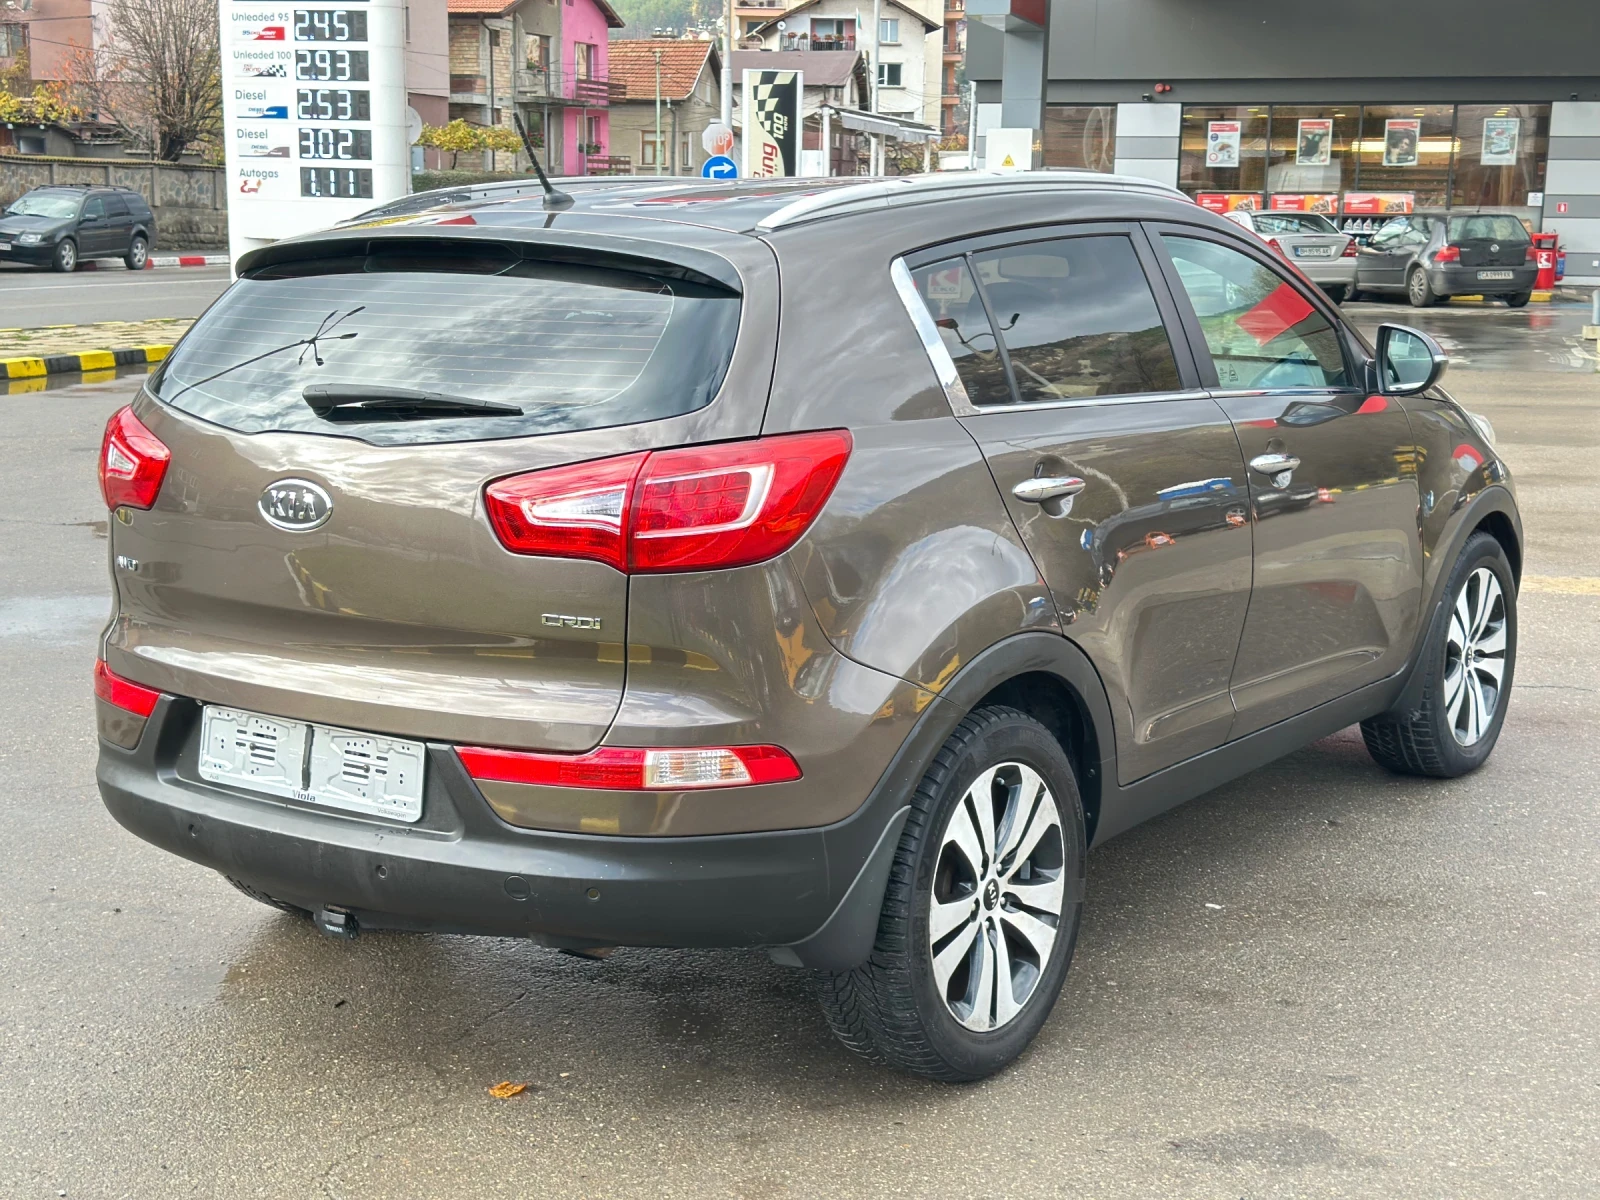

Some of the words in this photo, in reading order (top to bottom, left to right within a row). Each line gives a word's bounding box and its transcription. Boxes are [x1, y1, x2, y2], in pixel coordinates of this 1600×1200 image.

[232, 12, 275, 22] Unleaded
[277, 12, 289, 22] 95
[295, 10, 349, 41] 2.45
[233, 50, 274, 60] Unleaded
[276, 50, 292, 60] 100
[296, 50, 351, 80] 2.93
[235, 89, 267, 100] Diesel
[298, 89, 352, 119] 2.53
[236, 128, 268, 139] Diesel
[773, 112, 784, 139] 100
[300, 128, 353, 159] 3.02
[239, 168, 279, 180] Autogas
[310, 169, 355, 196] 1.11
[268, 488, 317, 520] KIA
[292, 789, 317, 803] Viola
[377, 807, 407, 819] Volkswagen
